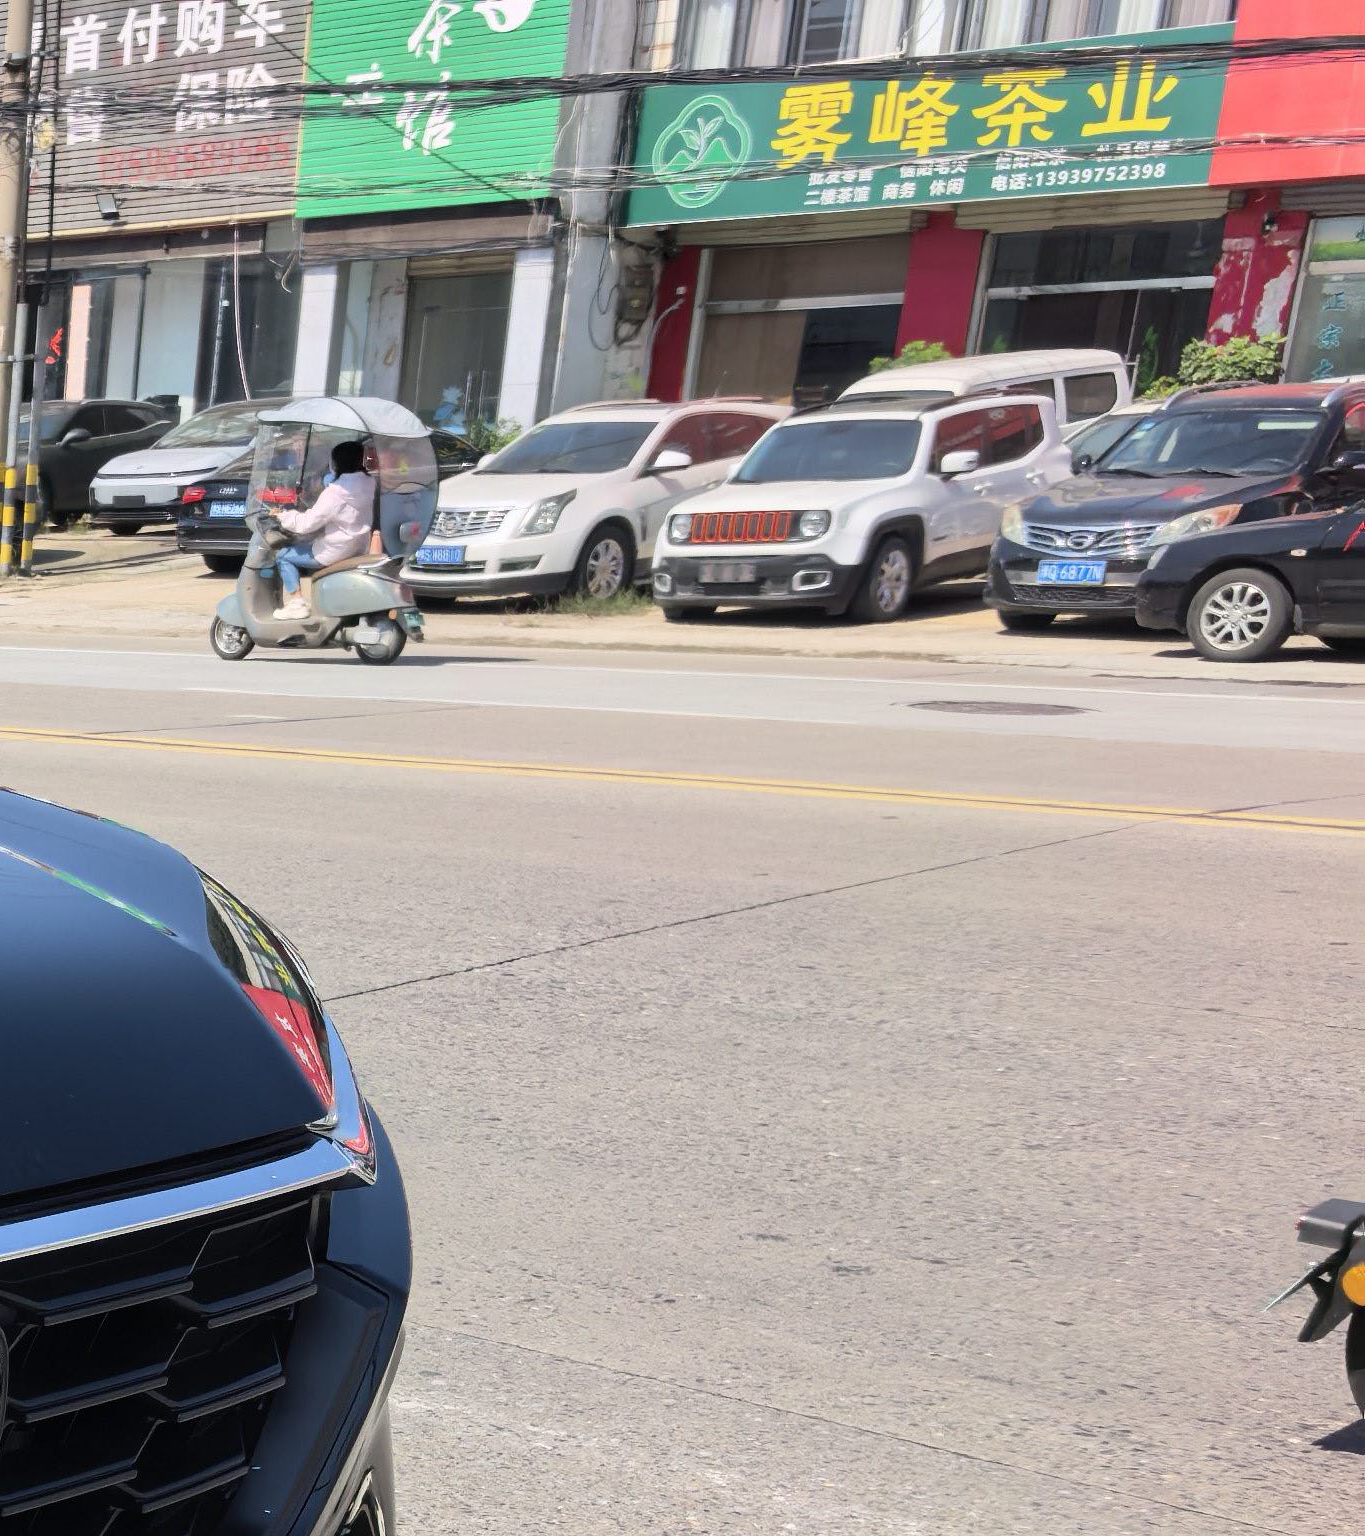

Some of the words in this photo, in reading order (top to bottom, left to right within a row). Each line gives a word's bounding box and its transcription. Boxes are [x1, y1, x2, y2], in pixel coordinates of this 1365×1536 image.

[770, 58, 1182, 169] 雾峰茶业
[882, 182, 916, 200] 商务
[929, 177, 965, 197] 休闲
[990, 161, 1166, 192] 电话:13939752398
